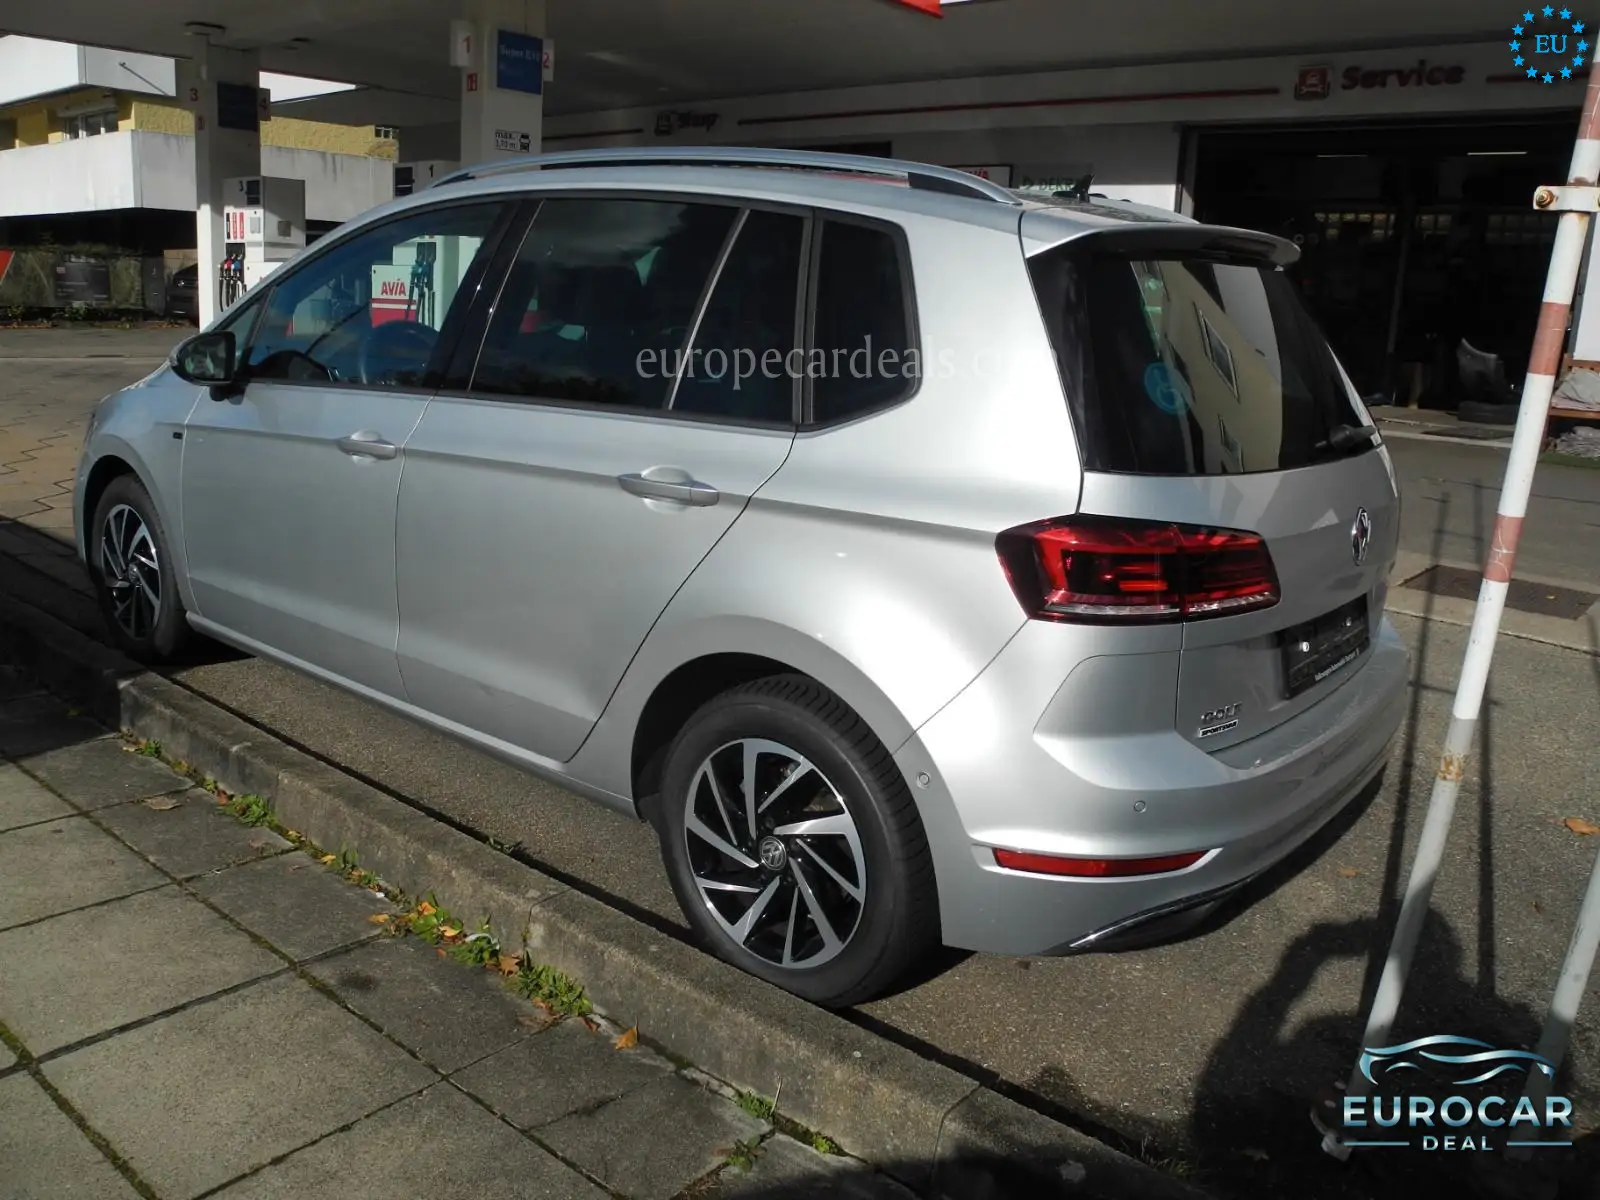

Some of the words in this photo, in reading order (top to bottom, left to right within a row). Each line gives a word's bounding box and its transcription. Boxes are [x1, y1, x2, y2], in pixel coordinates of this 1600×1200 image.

[463, 35, 472, 54] 1
[542, 52, 550, 69] 2
[1341, 59, 1466, 90] Service
[428, 163, 434, 177] 1
